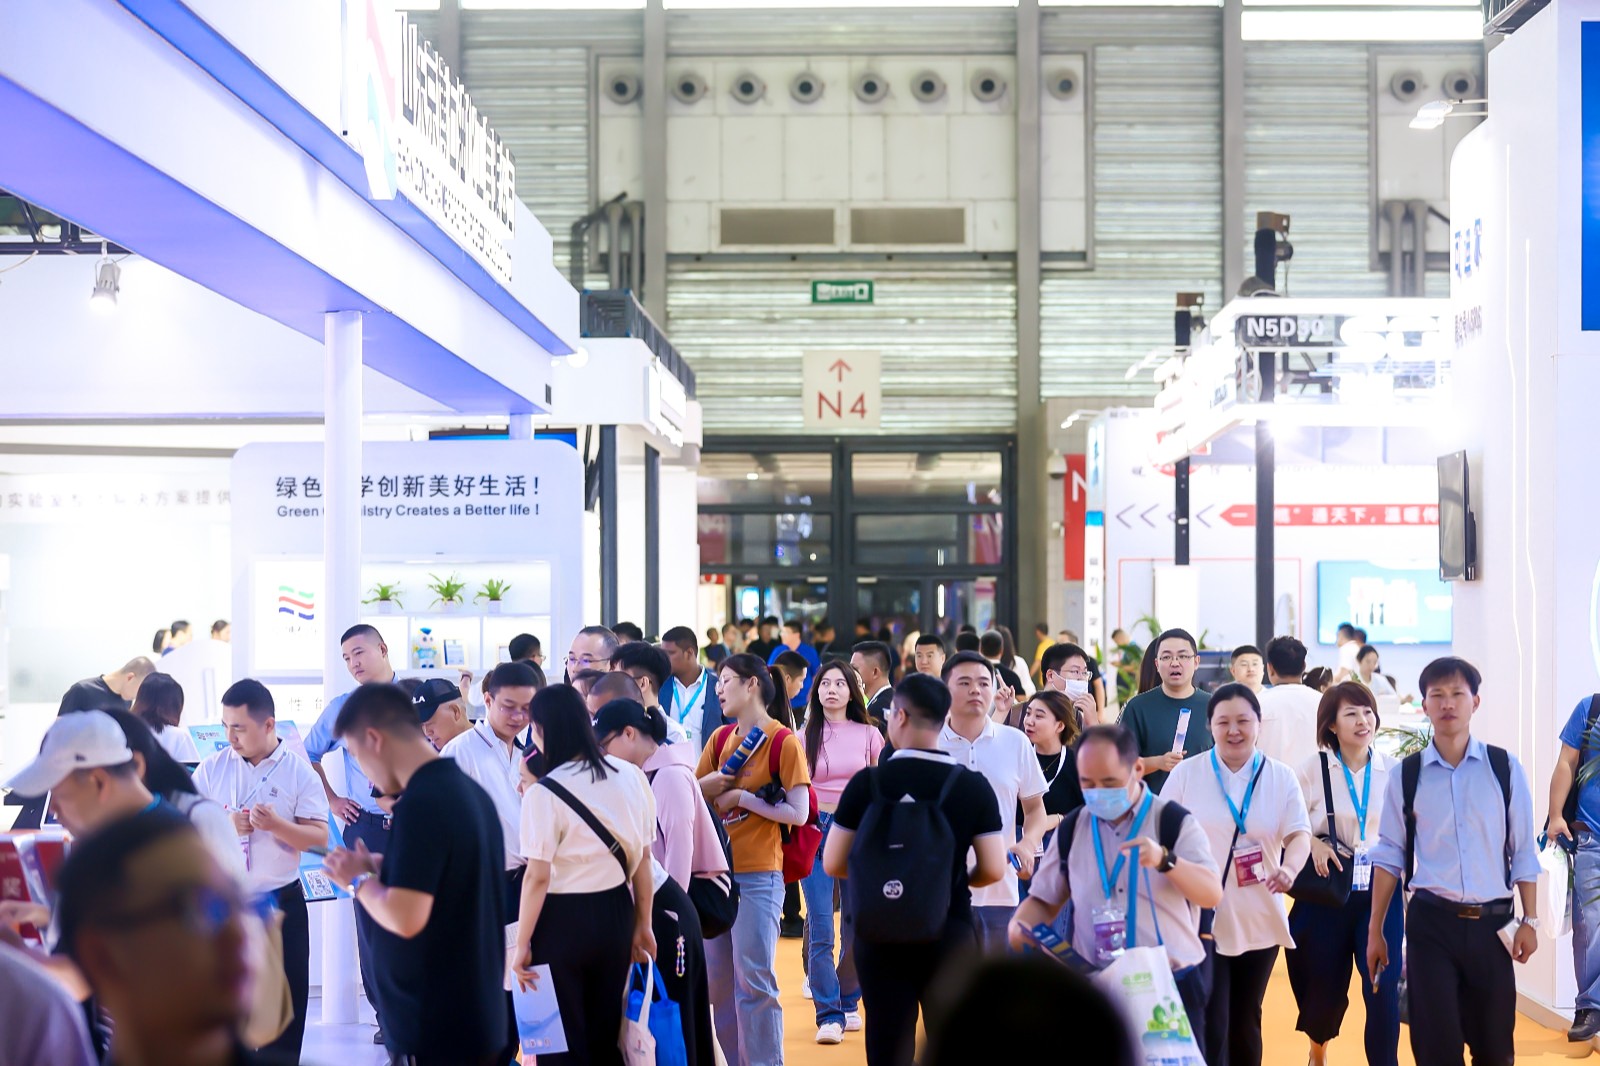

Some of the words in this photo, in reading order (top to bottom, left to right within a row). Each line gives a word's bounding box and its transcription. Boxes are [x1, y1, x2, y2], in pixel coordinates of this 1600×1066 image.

[817, 391, 867, 419] N4
[276, 475, 539, 498] 绿色学创新美好生活！
[277, 505, 318, 517] Green
[396, 504, 449, 516] Creates
[453, 507, 461, 516] a
[465, 503, 506, 516] Better
